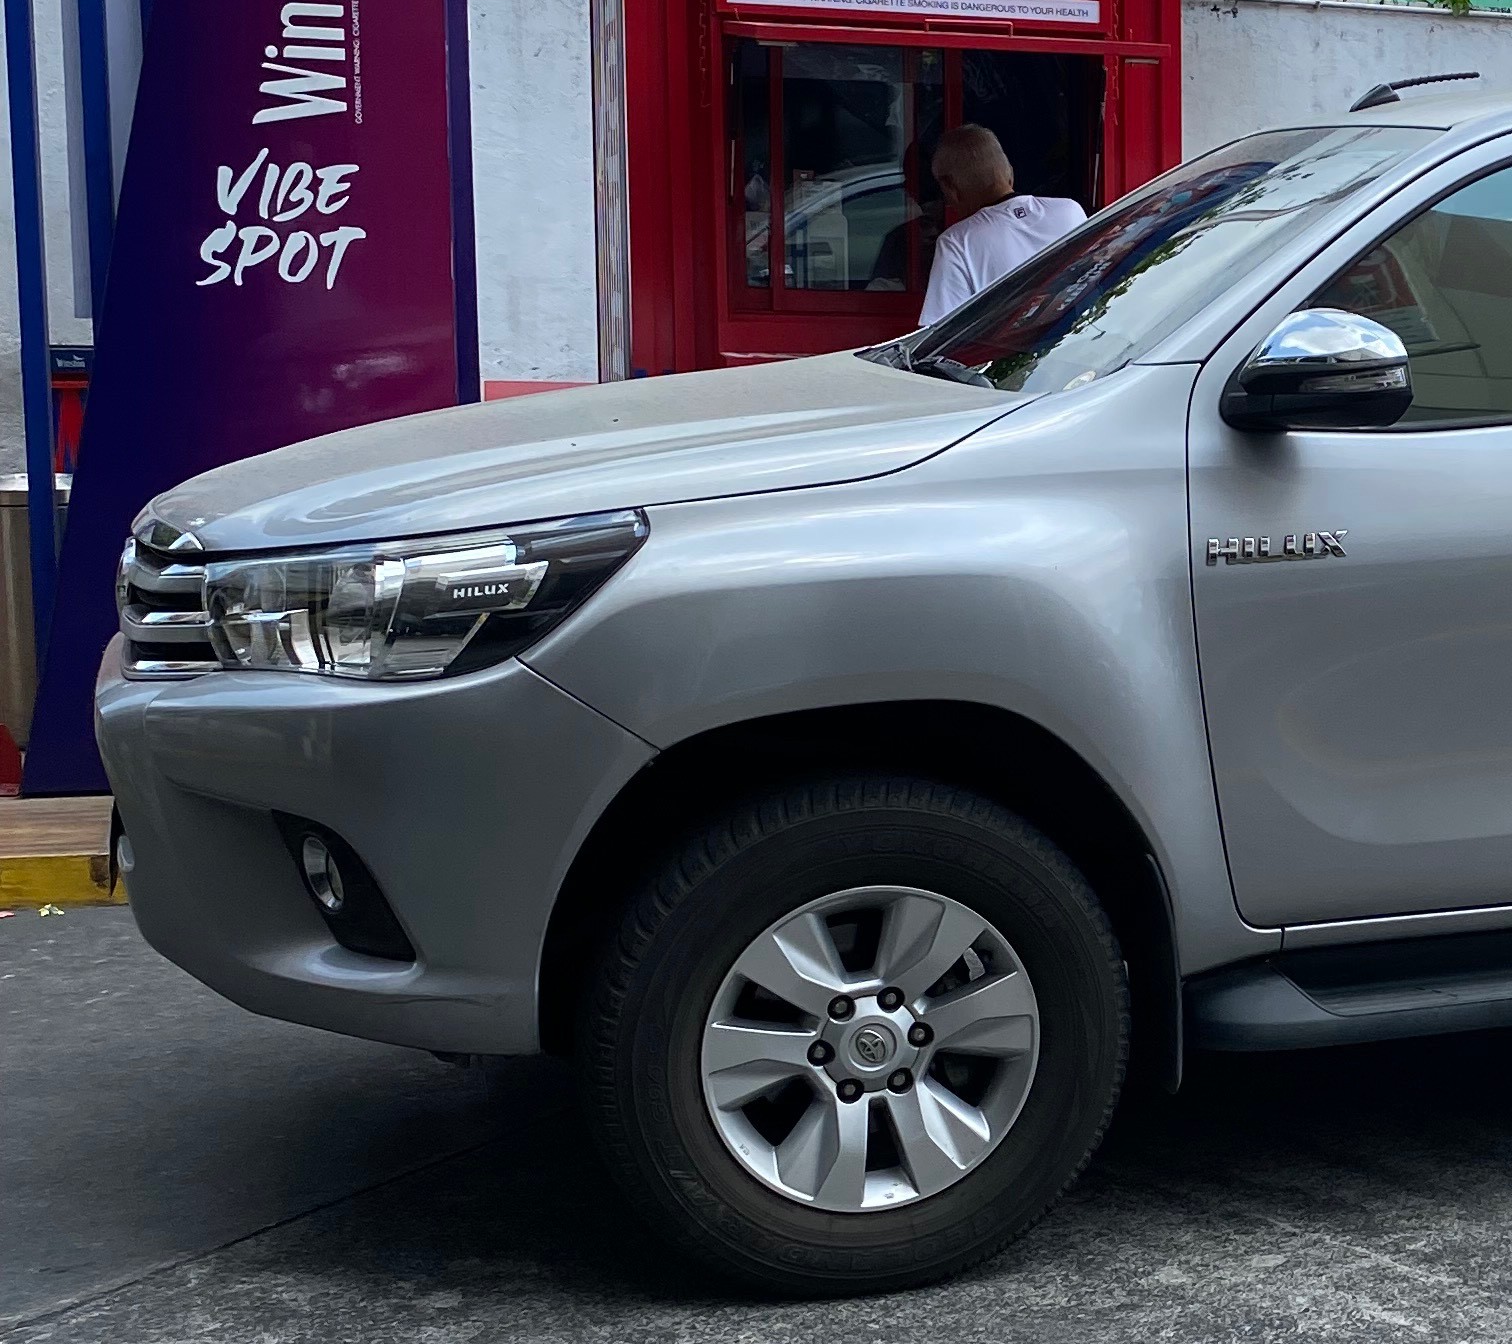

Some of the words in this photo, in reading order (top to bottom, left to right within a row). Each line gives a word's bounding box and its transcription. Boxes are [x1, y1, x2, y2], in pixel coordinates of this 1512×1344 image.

[351, 0, 360, 36] CIGARETTE
[907, 0, 950, 10] SMOKING
[950, 1, 959, 10] IS
[960, 2, 1016, 14] DANGEROUS
[1017, 5, 1028, 14] TO
[1030, 6, 1054, 16] YOUR
[1055, 7, 1089, 18] HEALTH
[354, 76, 363, 124] GOVERNMENT
[216, 147, 360, 223] VIBE
[195, 220, 367, 290] SPOT
[1206, 529, 1349, 567] HILUX
[453, 583, 510, 599] HILUX
